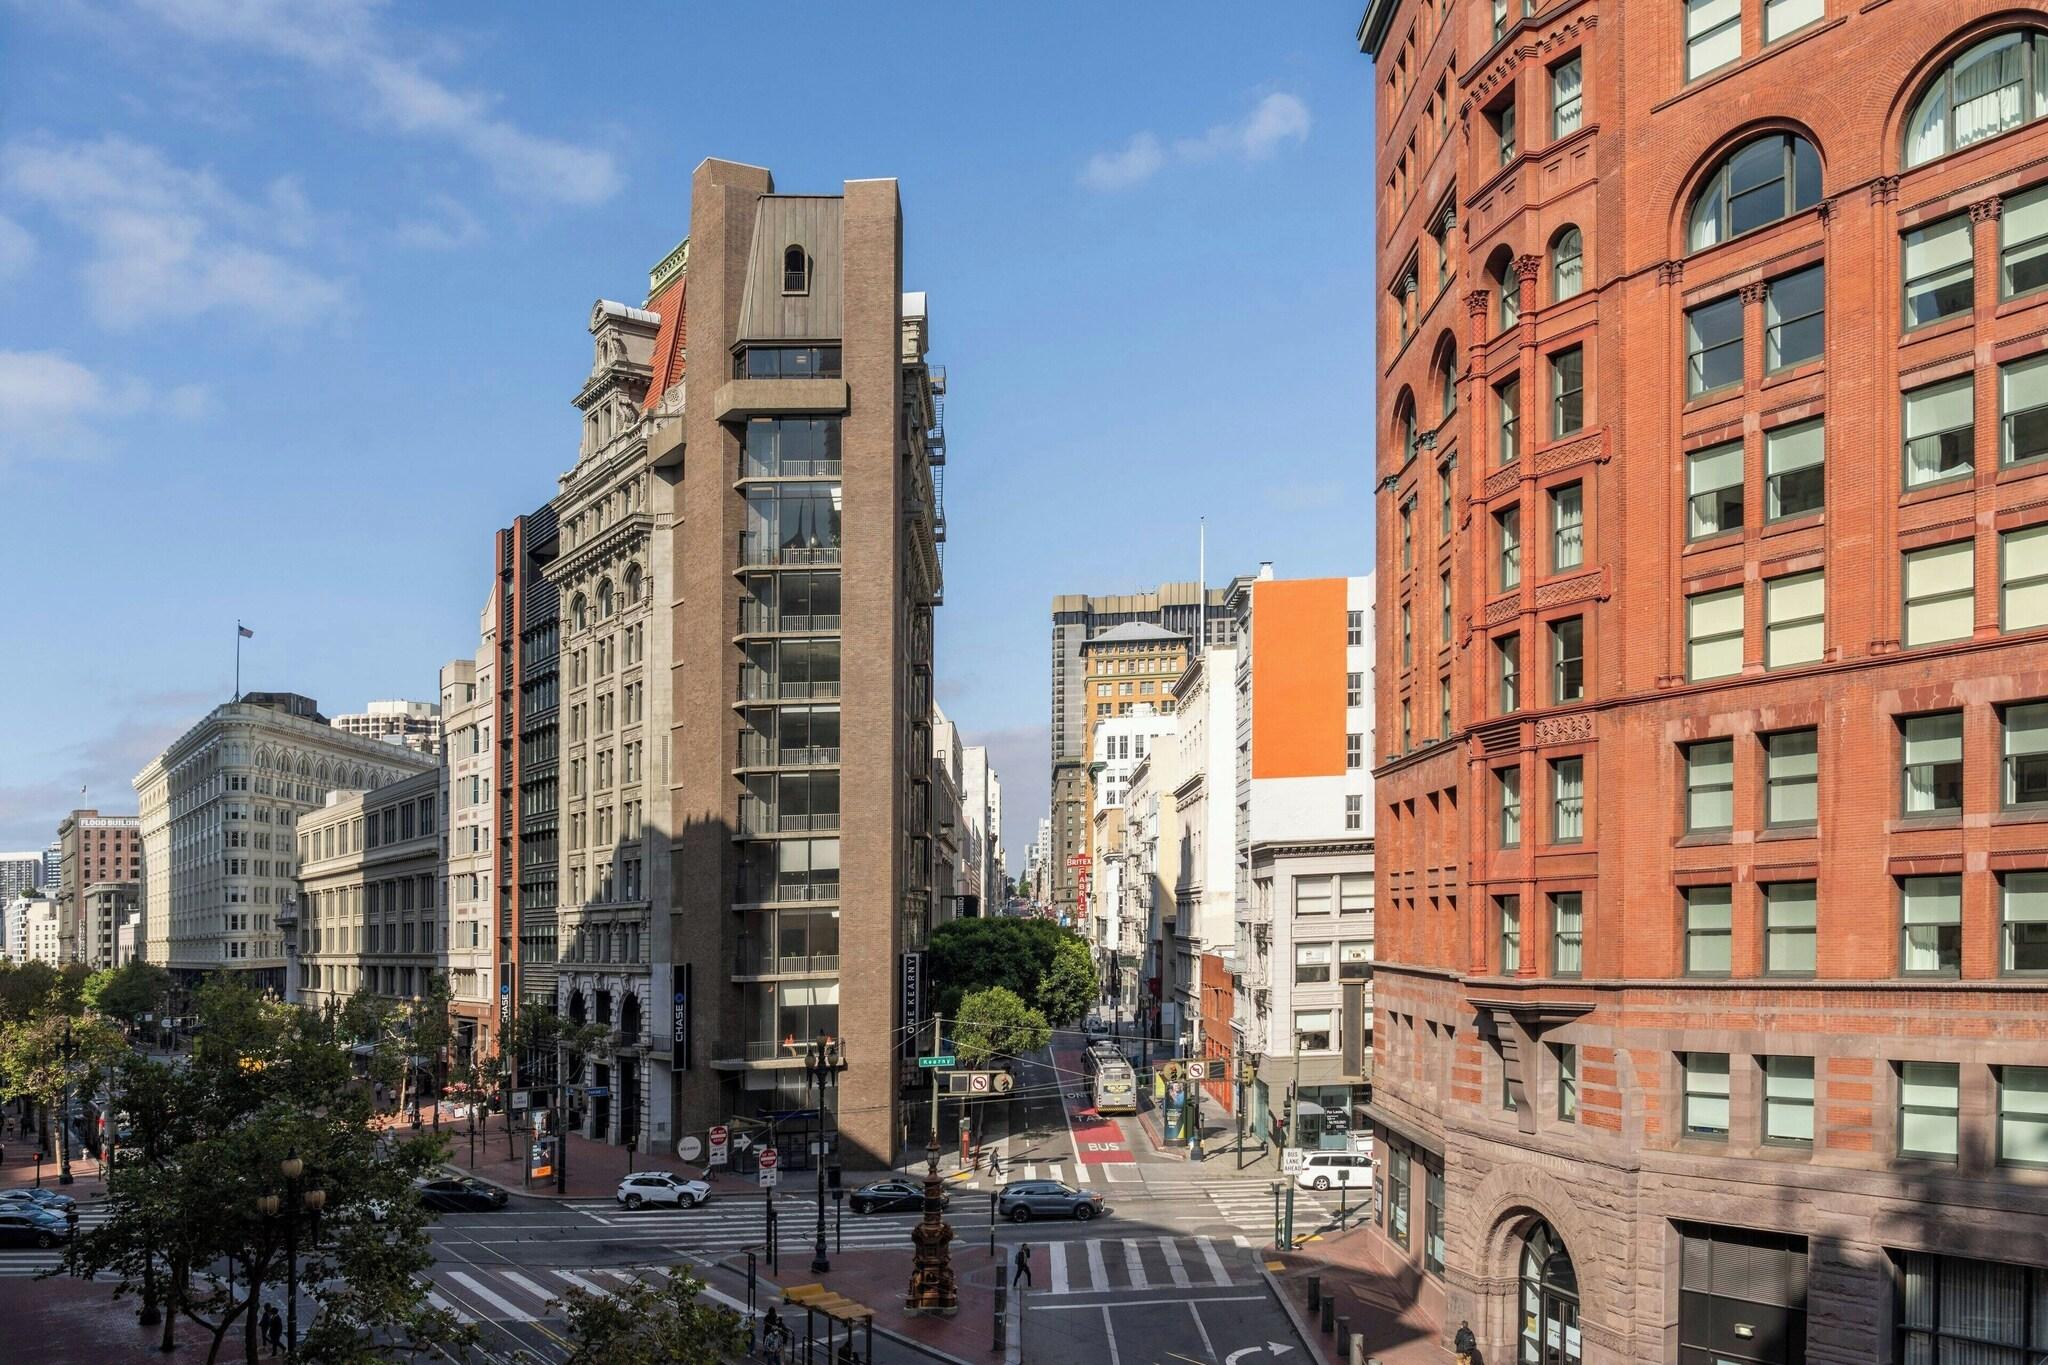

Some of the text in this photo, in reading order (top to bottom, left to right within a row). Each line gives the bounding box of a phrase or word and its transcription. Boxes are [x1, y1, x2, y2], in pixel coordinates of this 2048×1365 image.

[1067, 858, 1091, 866] BRITEX
[907, 959, 915, 1034] ONE KEARNY
[675, 1004, 683, 1042] CHASE
[1087, 1142, 1120, 1151] BUS
